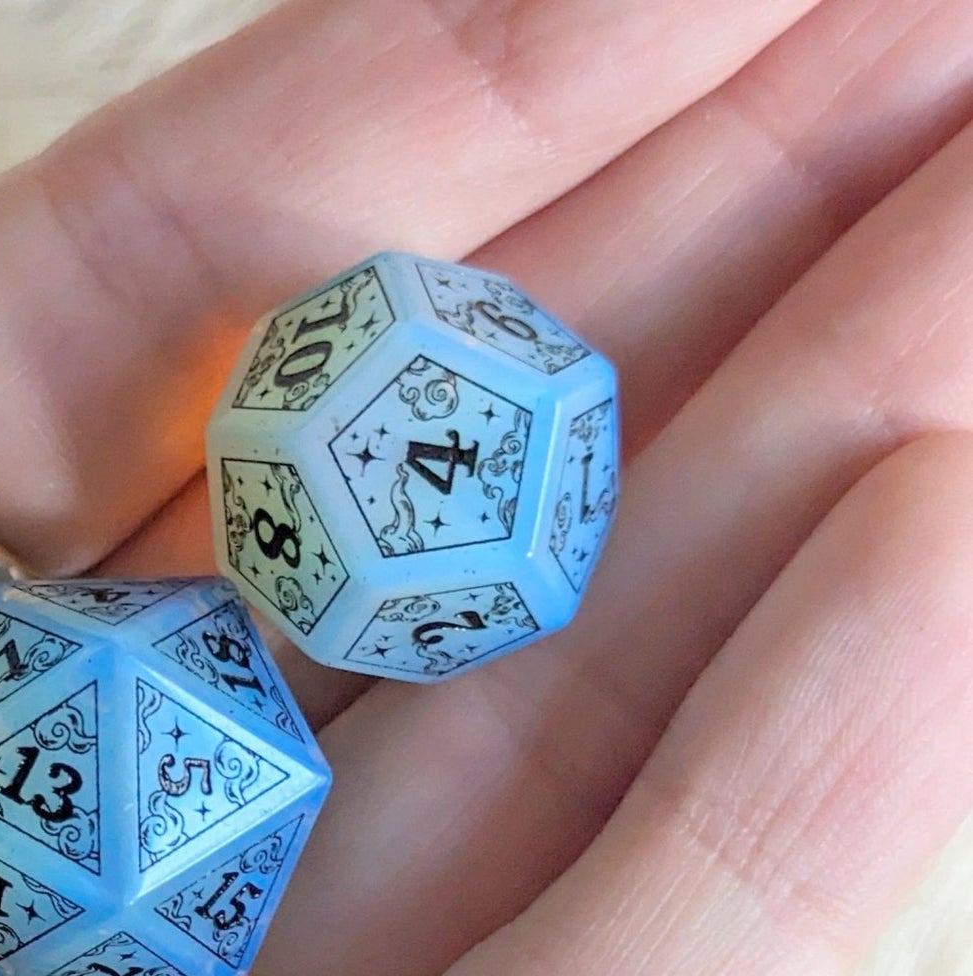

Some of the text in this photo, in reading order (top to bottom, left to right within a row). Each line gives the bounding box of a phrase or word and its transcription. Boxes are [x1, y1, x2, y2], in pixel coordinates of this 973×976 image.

[273, 306, 350, 388] 10
[404, 429, 480, 495] 4
[252, 507, 302, 570] 8
[157, 753, 214, 798] 5
[194, 870, 265, 931] 15
